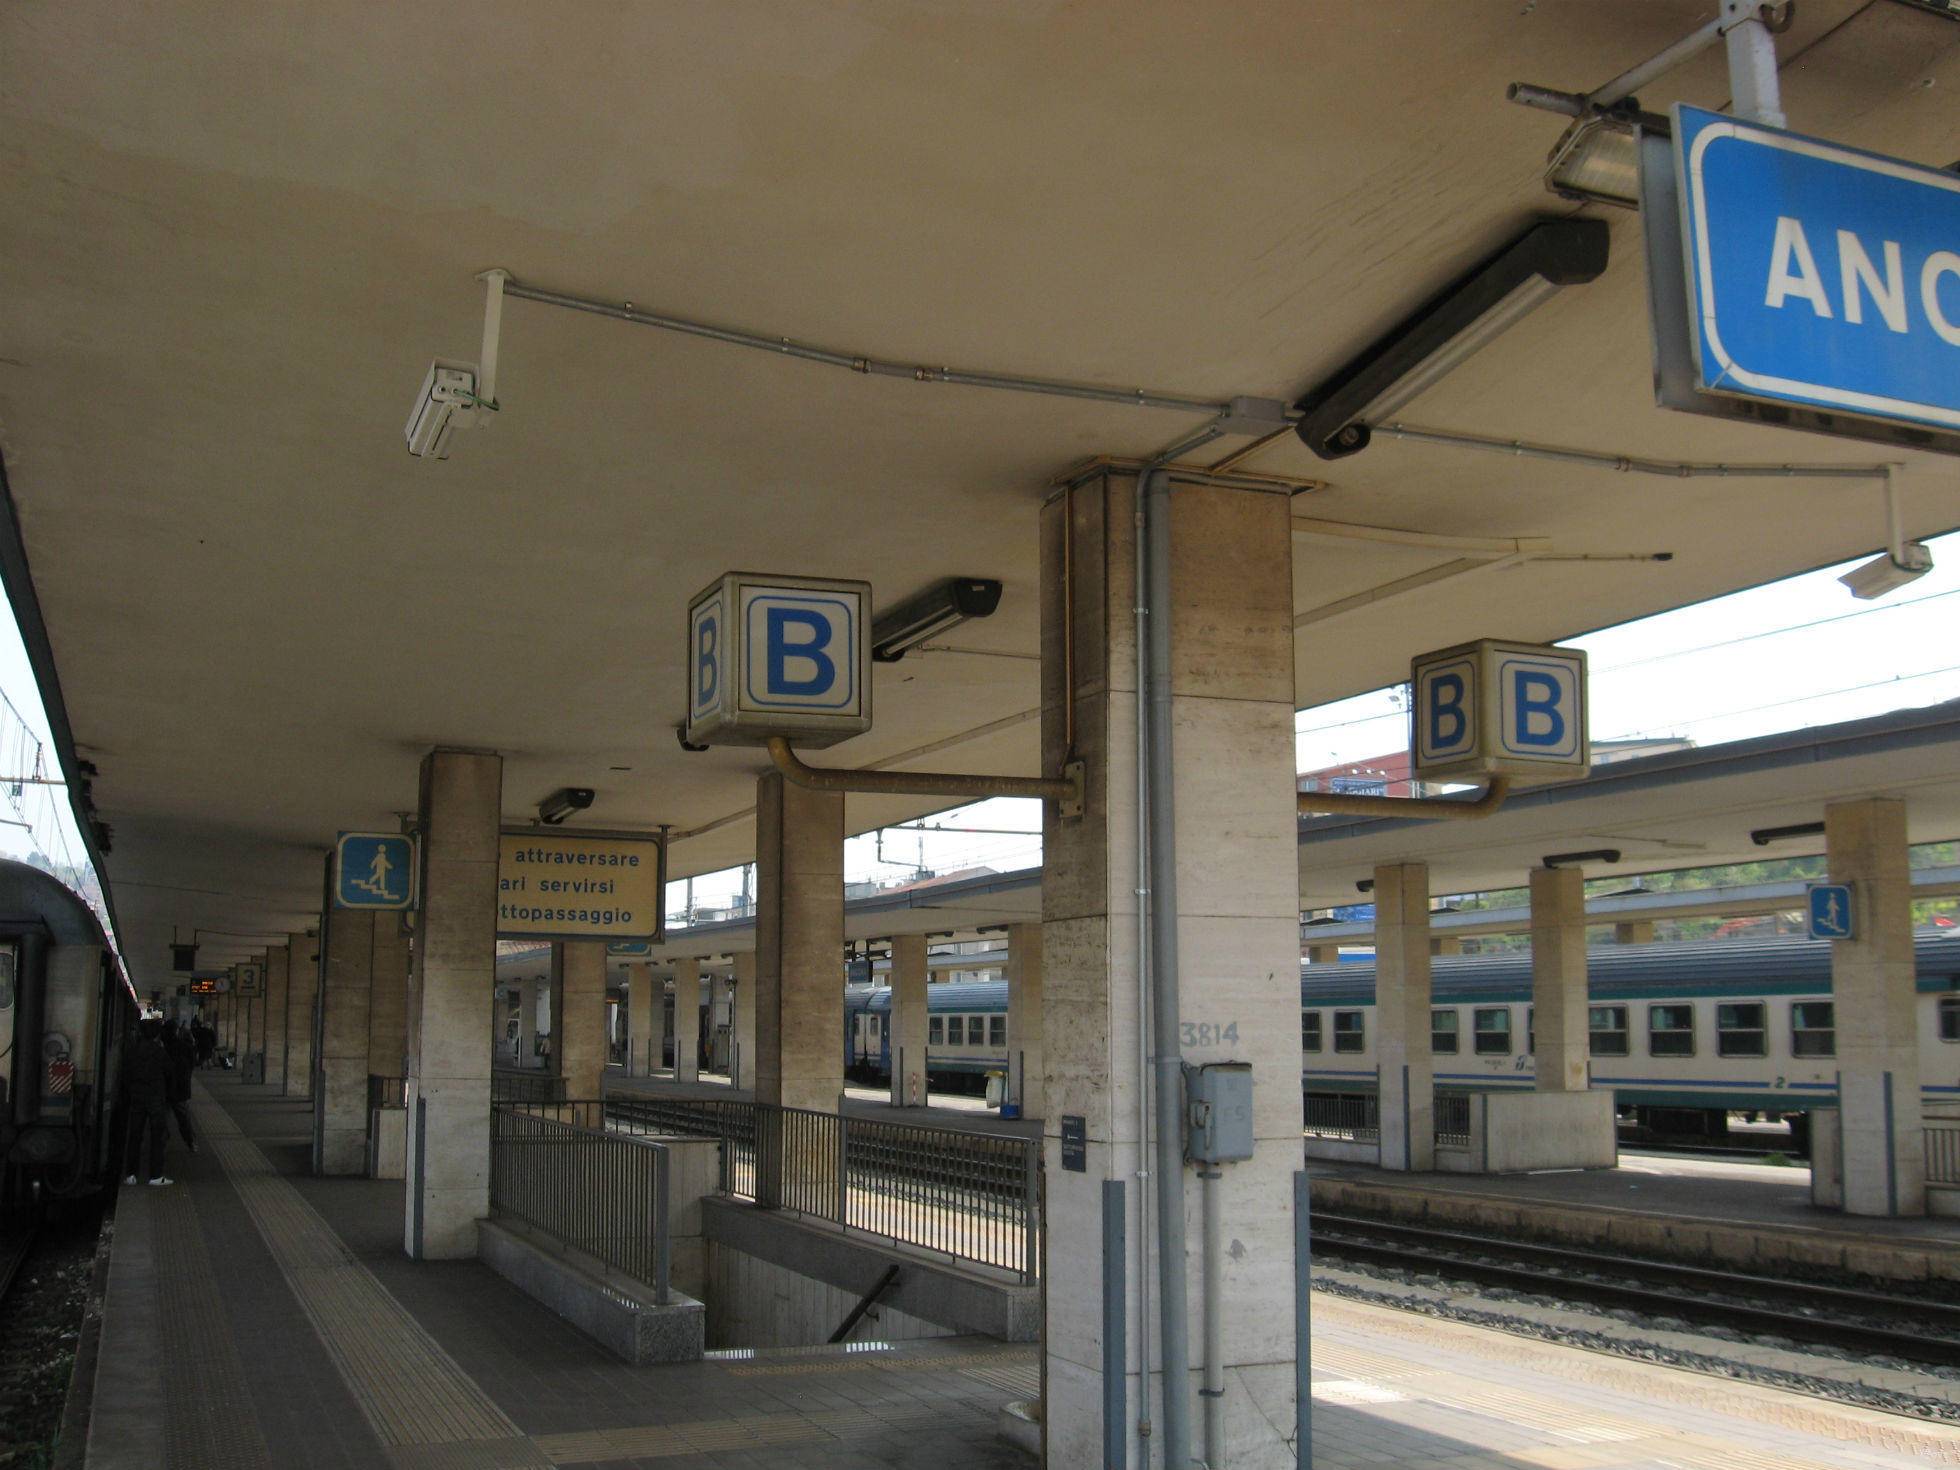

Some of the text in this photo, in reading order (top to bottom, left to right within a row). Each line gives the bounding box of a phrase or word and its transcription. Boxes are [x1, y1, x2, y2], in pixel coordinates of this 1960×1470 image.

[698, 616, 717, 708] B
[767, 607, 836, 696] B
[1430, 673, 1466, 750] B
[1515, 670, 1565, 746] B
[515, 848, 640, 867] attraversare
[540, 878, 615, 894] servirsi
[243, 969, 255, 984] 3
[1180, 1021, 1240, 1048] 3814
[1775, 1076, 1786, 1089] 2
